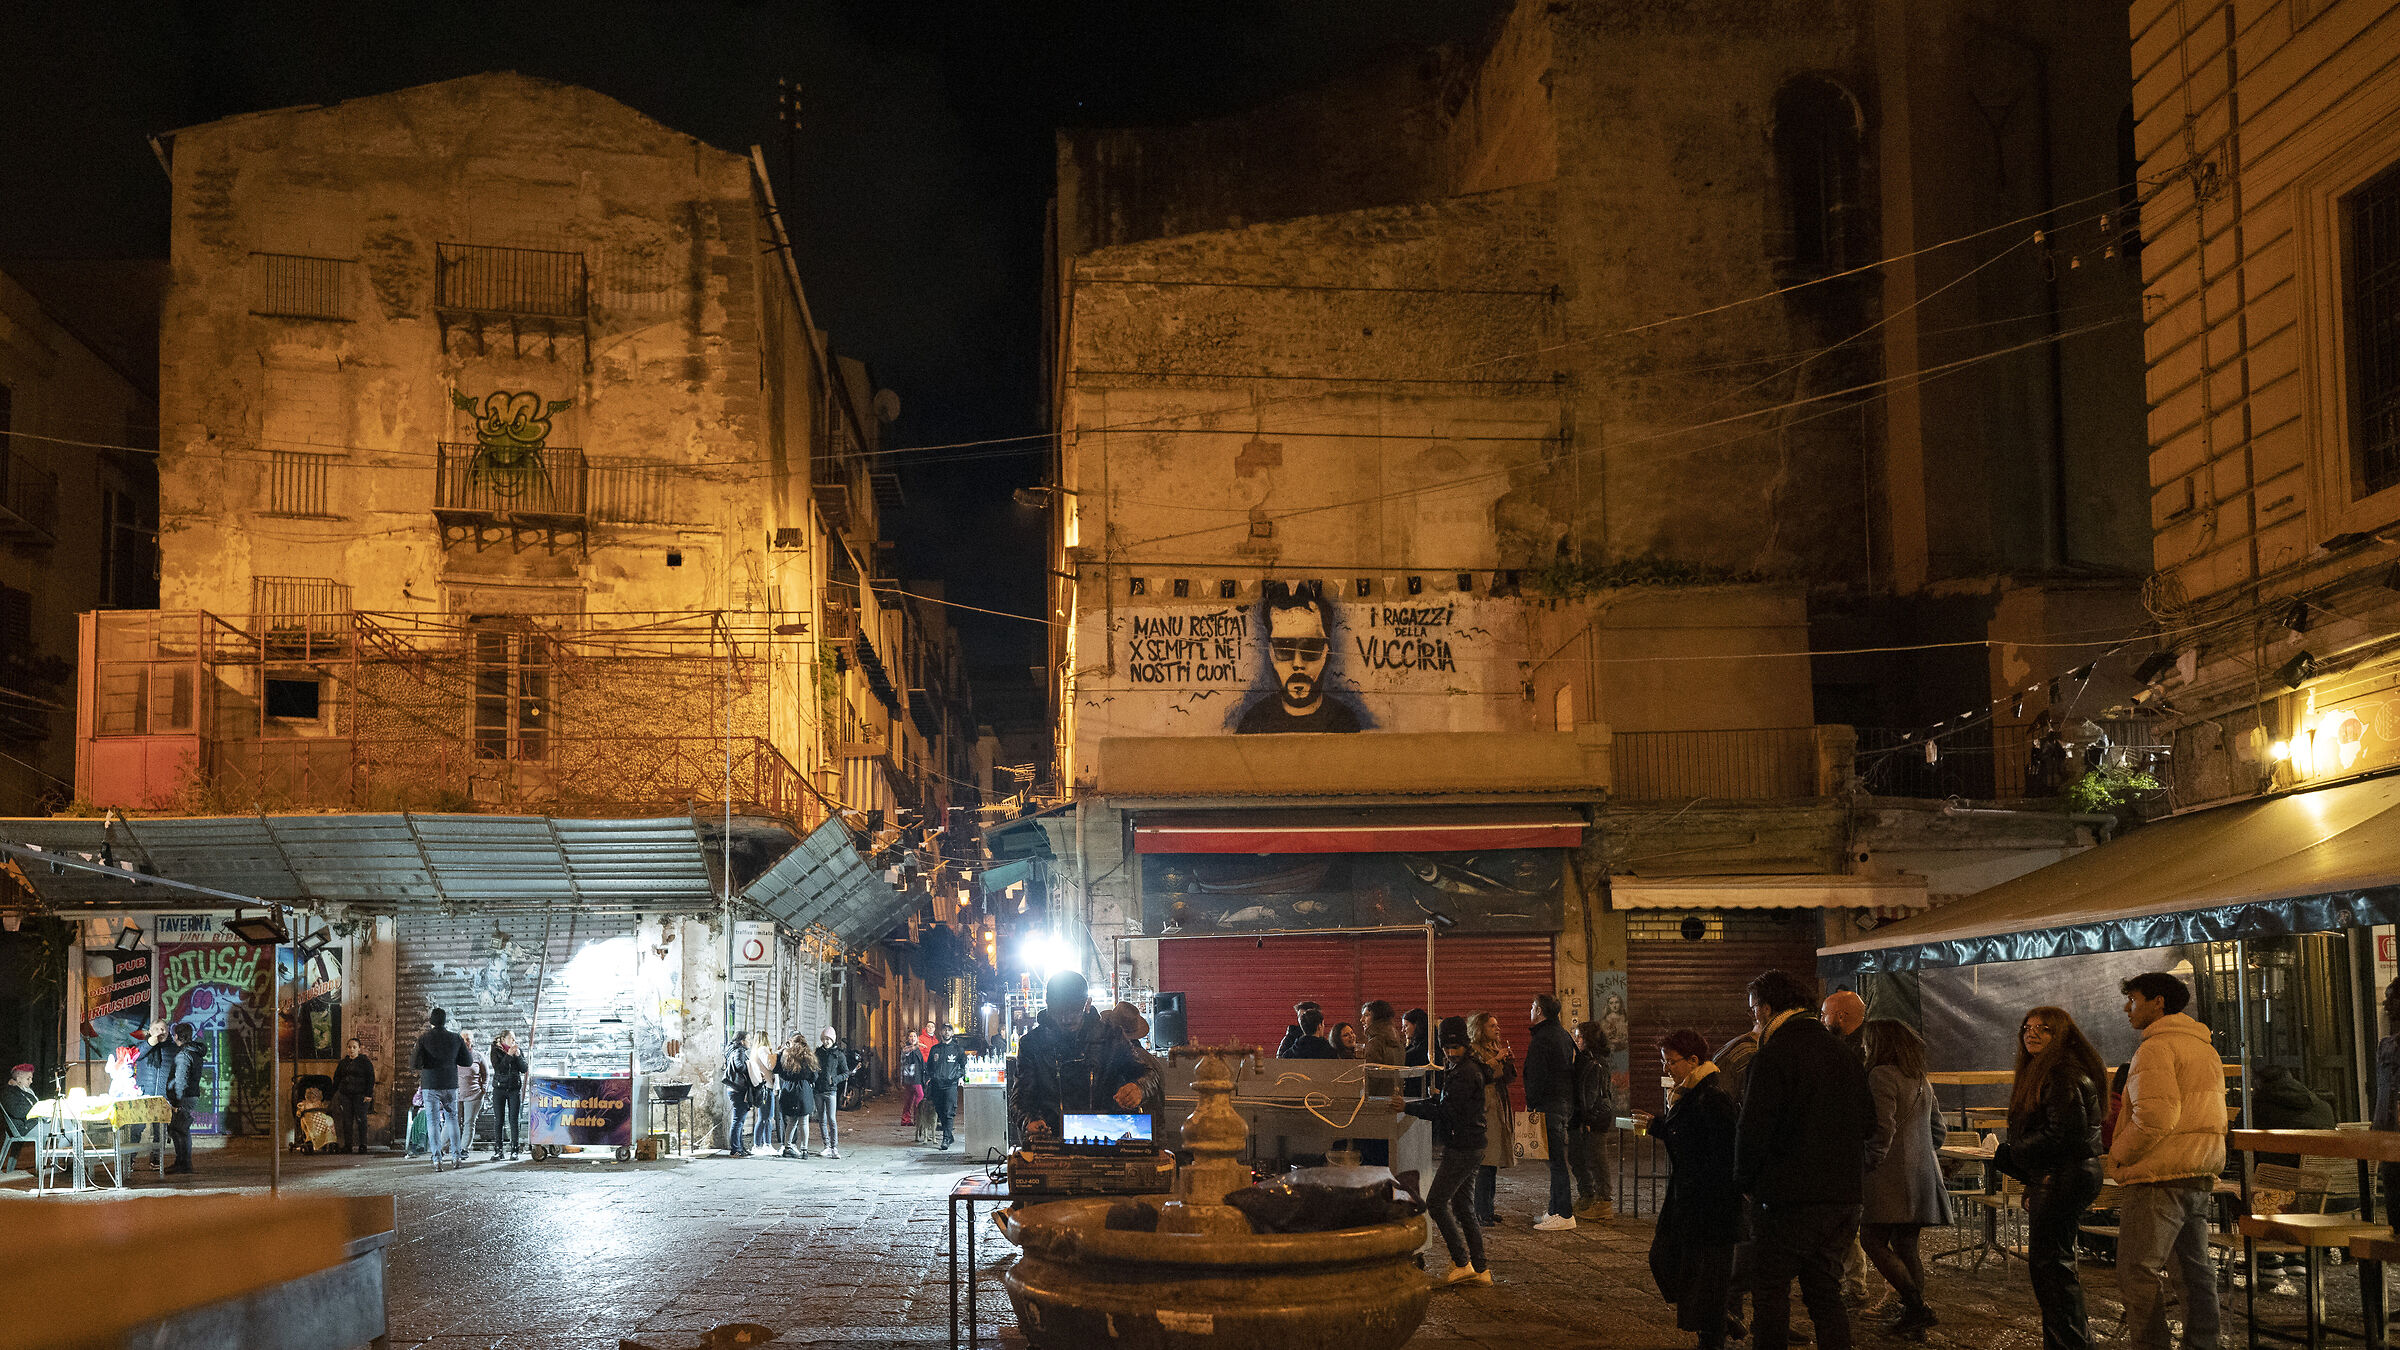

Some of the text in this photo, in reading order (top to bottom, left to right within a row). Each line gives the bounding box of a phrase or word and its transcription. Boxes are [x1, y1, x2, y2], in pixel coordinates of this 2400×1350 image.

[1133, 615, 1183, 639] MANU
[1395, 627, 1428, 637] DELLA
[1129, 639, 1144, 662] X
[159, 917, 212, 932] TAVERNA
[179, 932, 241, 942] VINI BIRR
[116, 957, 147, 974] PUB
[89, 973, 150, 997] DRINKERIA
[538, 1095, 624, 1109] il Panellaro
[560, 1113, 606, 1127] Matto
